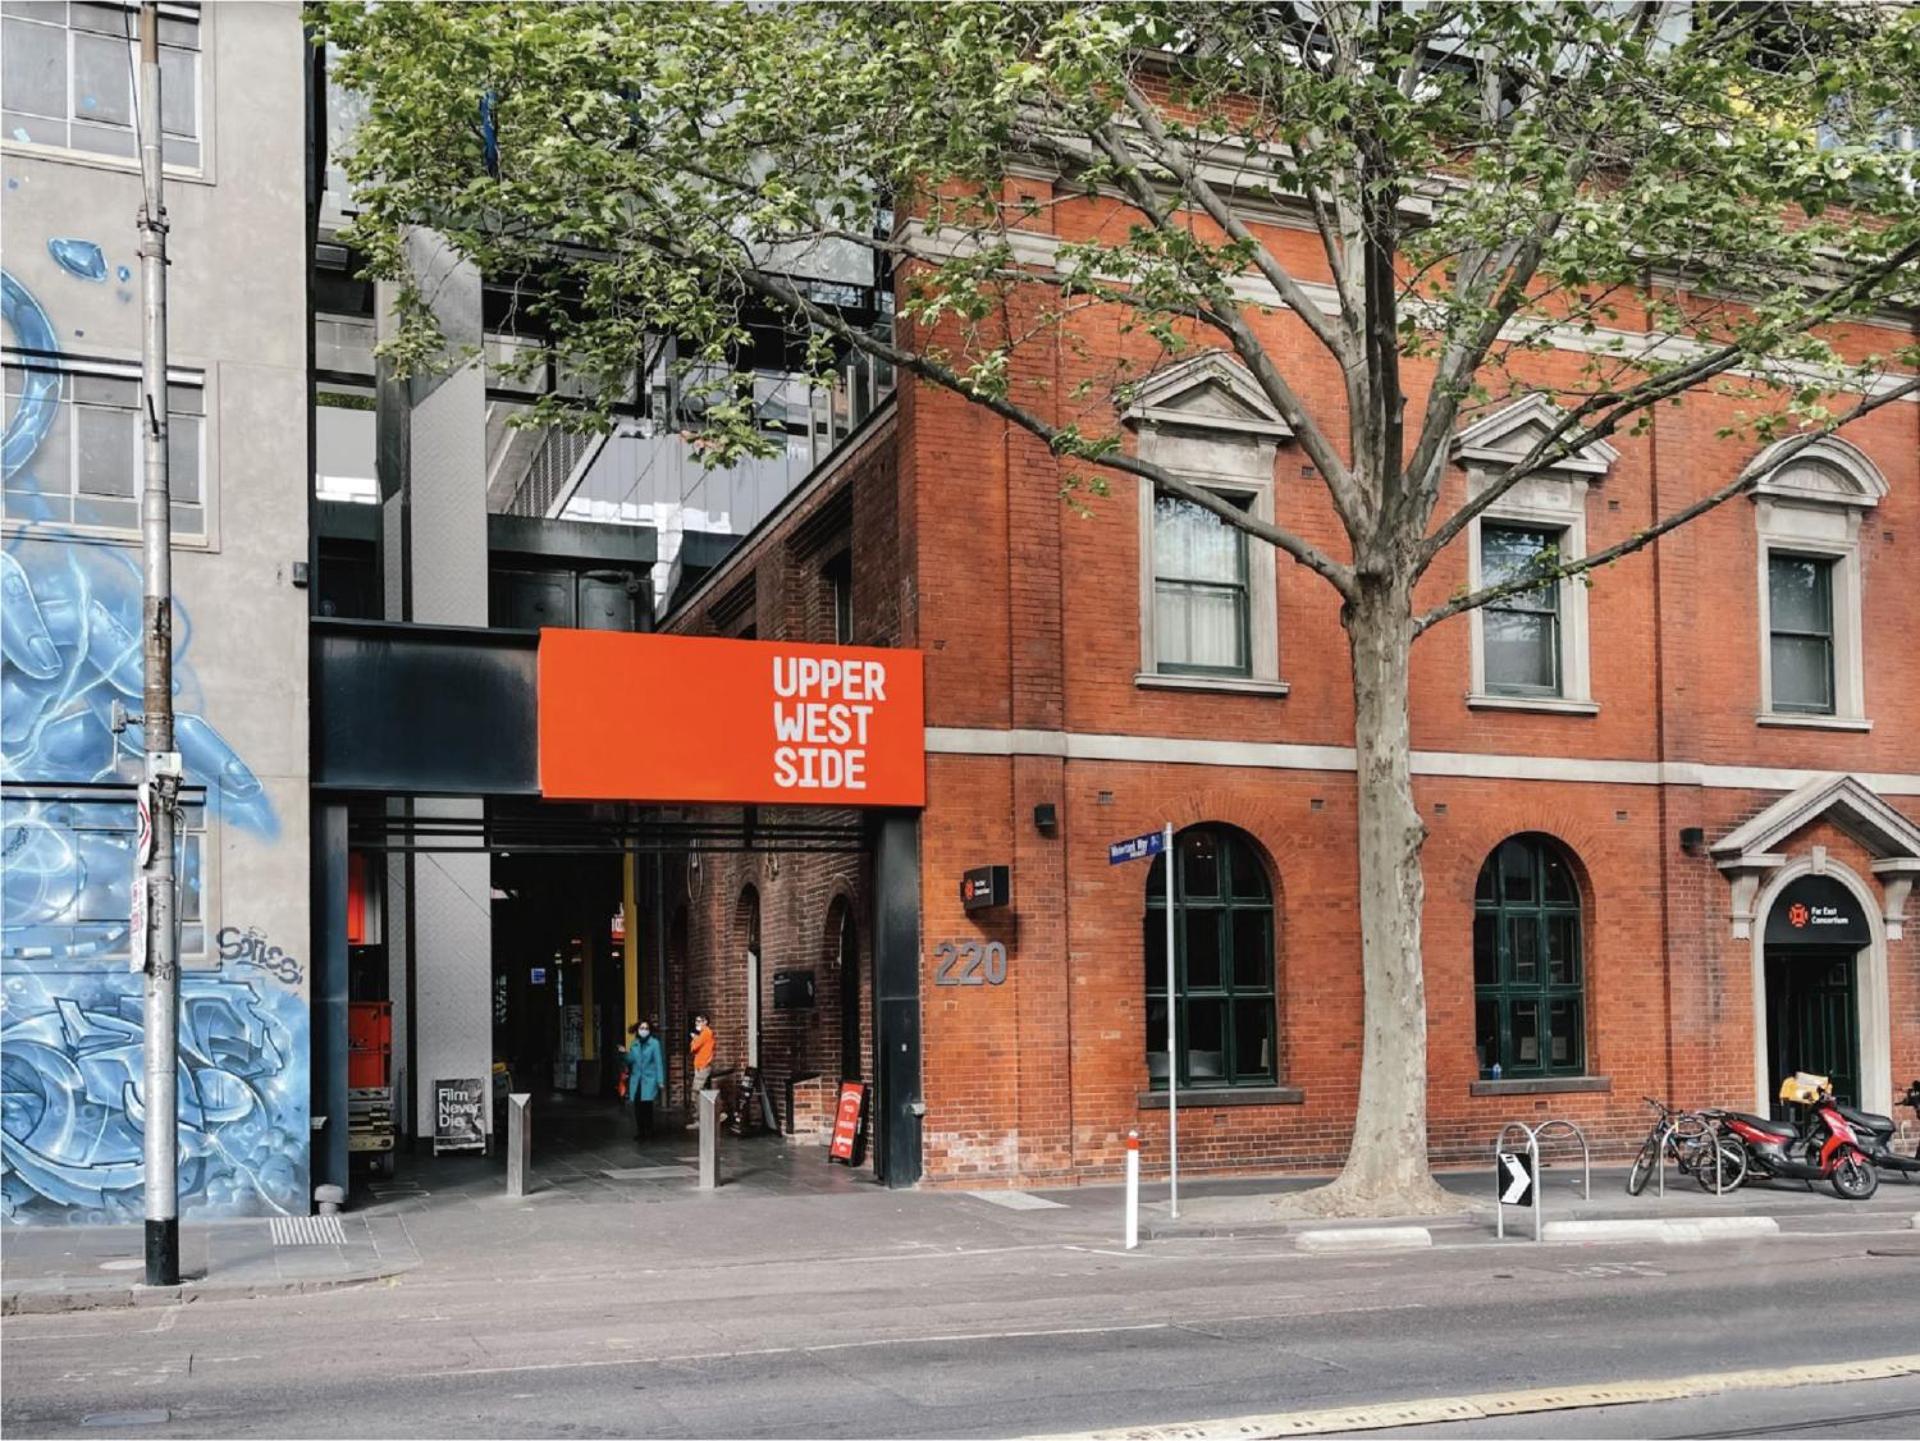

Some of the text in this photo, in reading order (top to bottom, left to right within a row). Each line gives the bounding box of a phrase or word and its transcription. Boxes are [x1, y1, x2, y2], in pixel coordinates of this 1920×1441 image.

[773, 656, 886, 701] UPPER
[773, 701, 874, 745] WEST
[773, 746, 867, 789] SIDE
[934, 941, 1007, 986] 220
[438, 1088, 469, 1101] Film
[439, 1102, 481, 1114] Never
